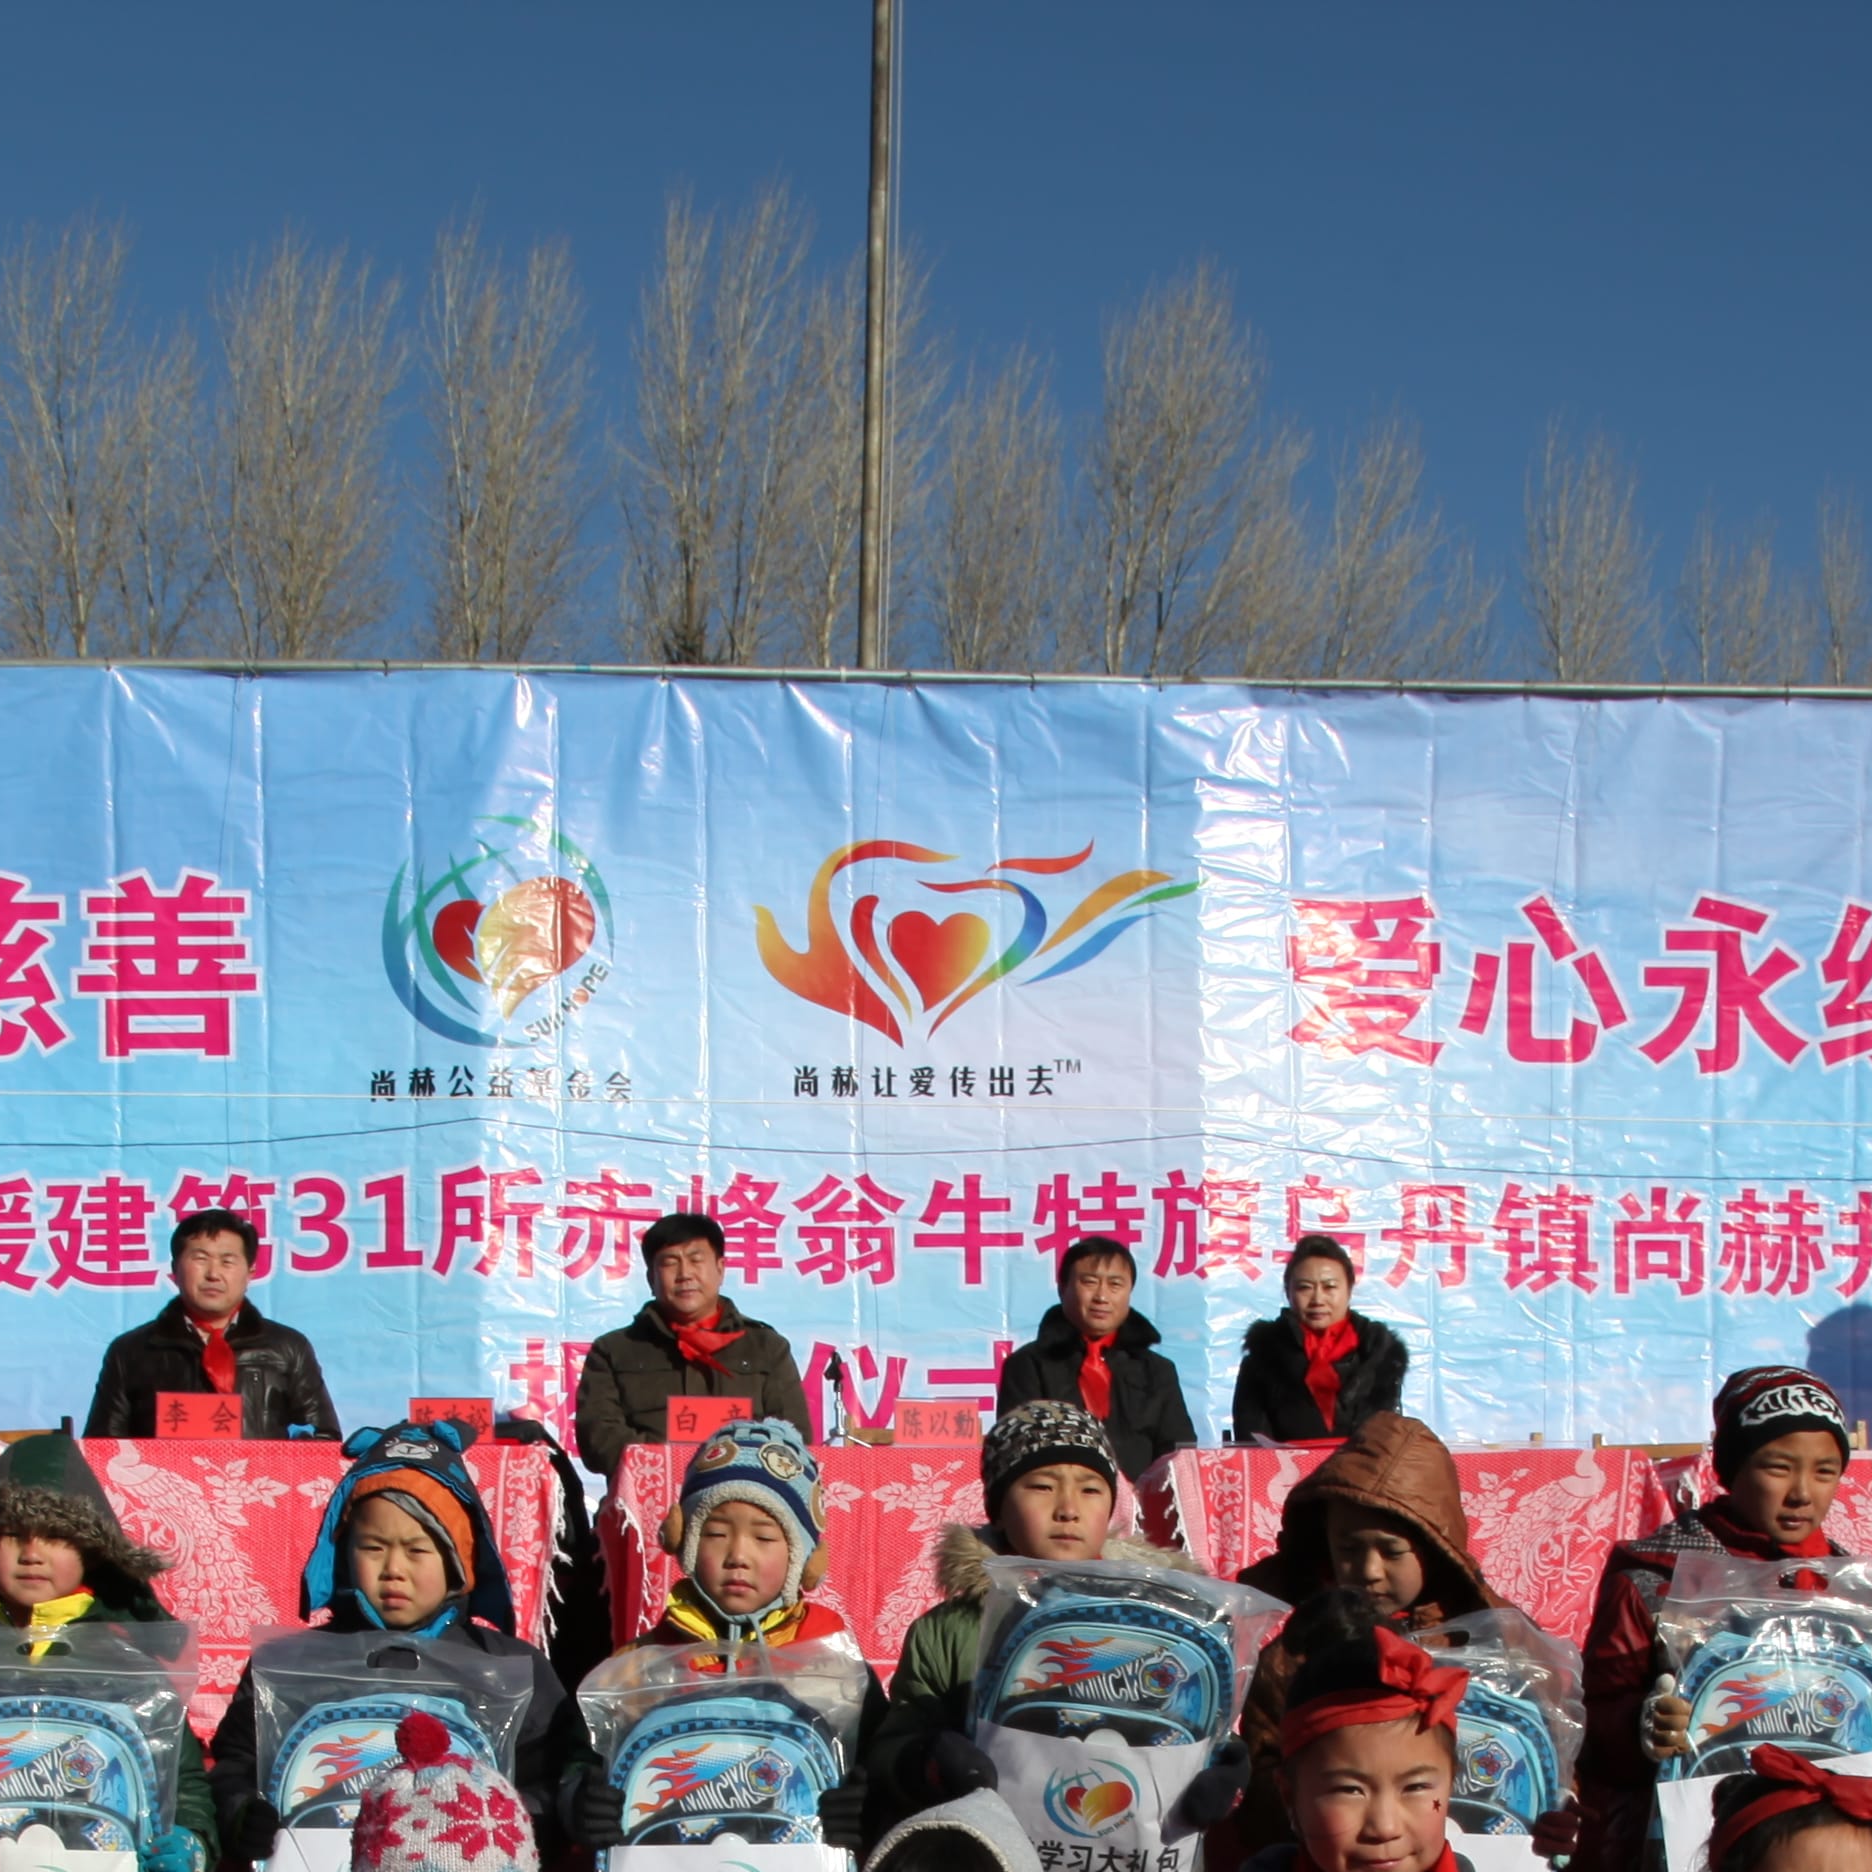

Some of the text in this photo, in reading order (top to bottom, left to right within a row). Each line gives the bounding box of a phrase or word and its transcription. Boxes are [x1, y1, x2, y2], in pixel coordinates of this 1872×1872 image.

[793, 1065, 1054, 1098] 尚赫让爱传出去
